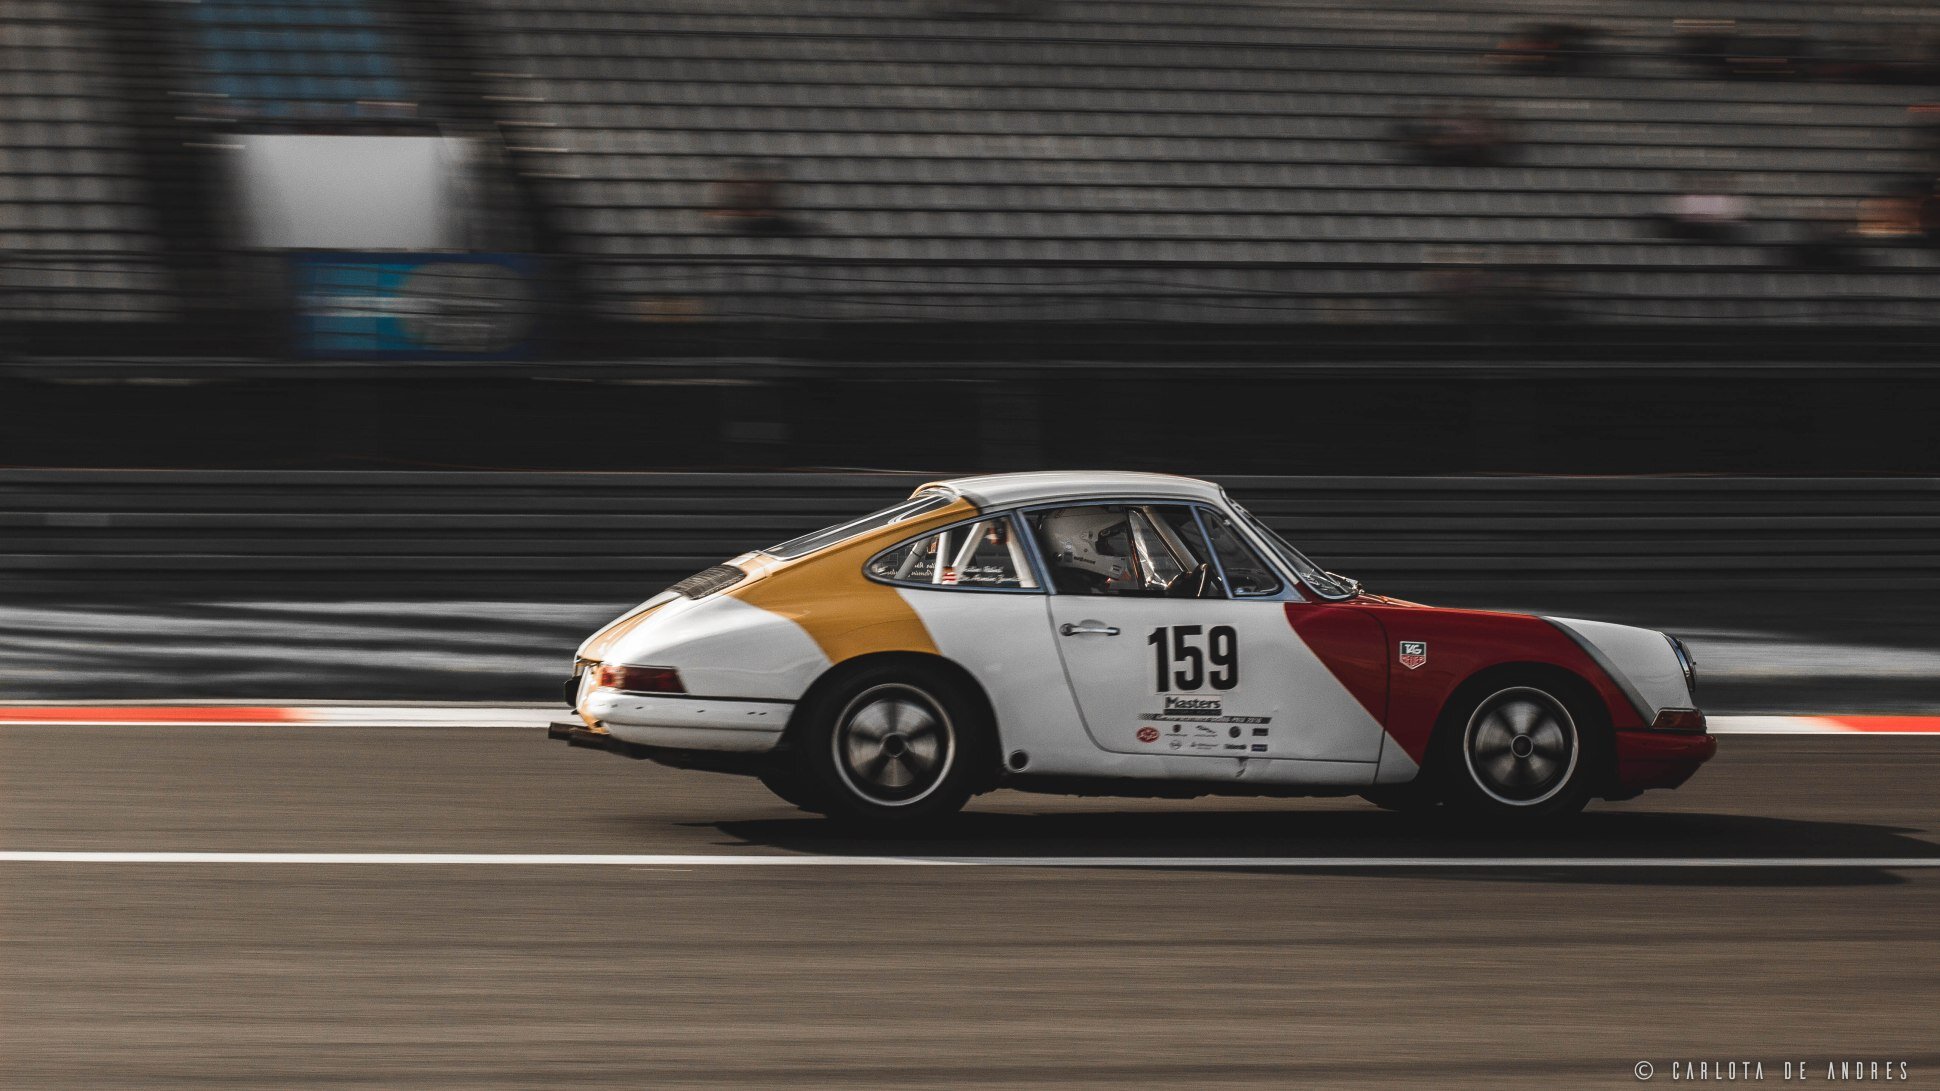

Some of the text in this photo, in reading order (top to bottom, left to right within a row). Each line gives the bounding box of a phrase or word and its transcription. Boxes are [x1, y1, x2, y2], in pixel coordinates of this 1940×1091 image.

[1404, 643, 1422, 655] TAG
[1147, 624, 1239, 693] 159
[1165, 696, 1221, 709] Masters
